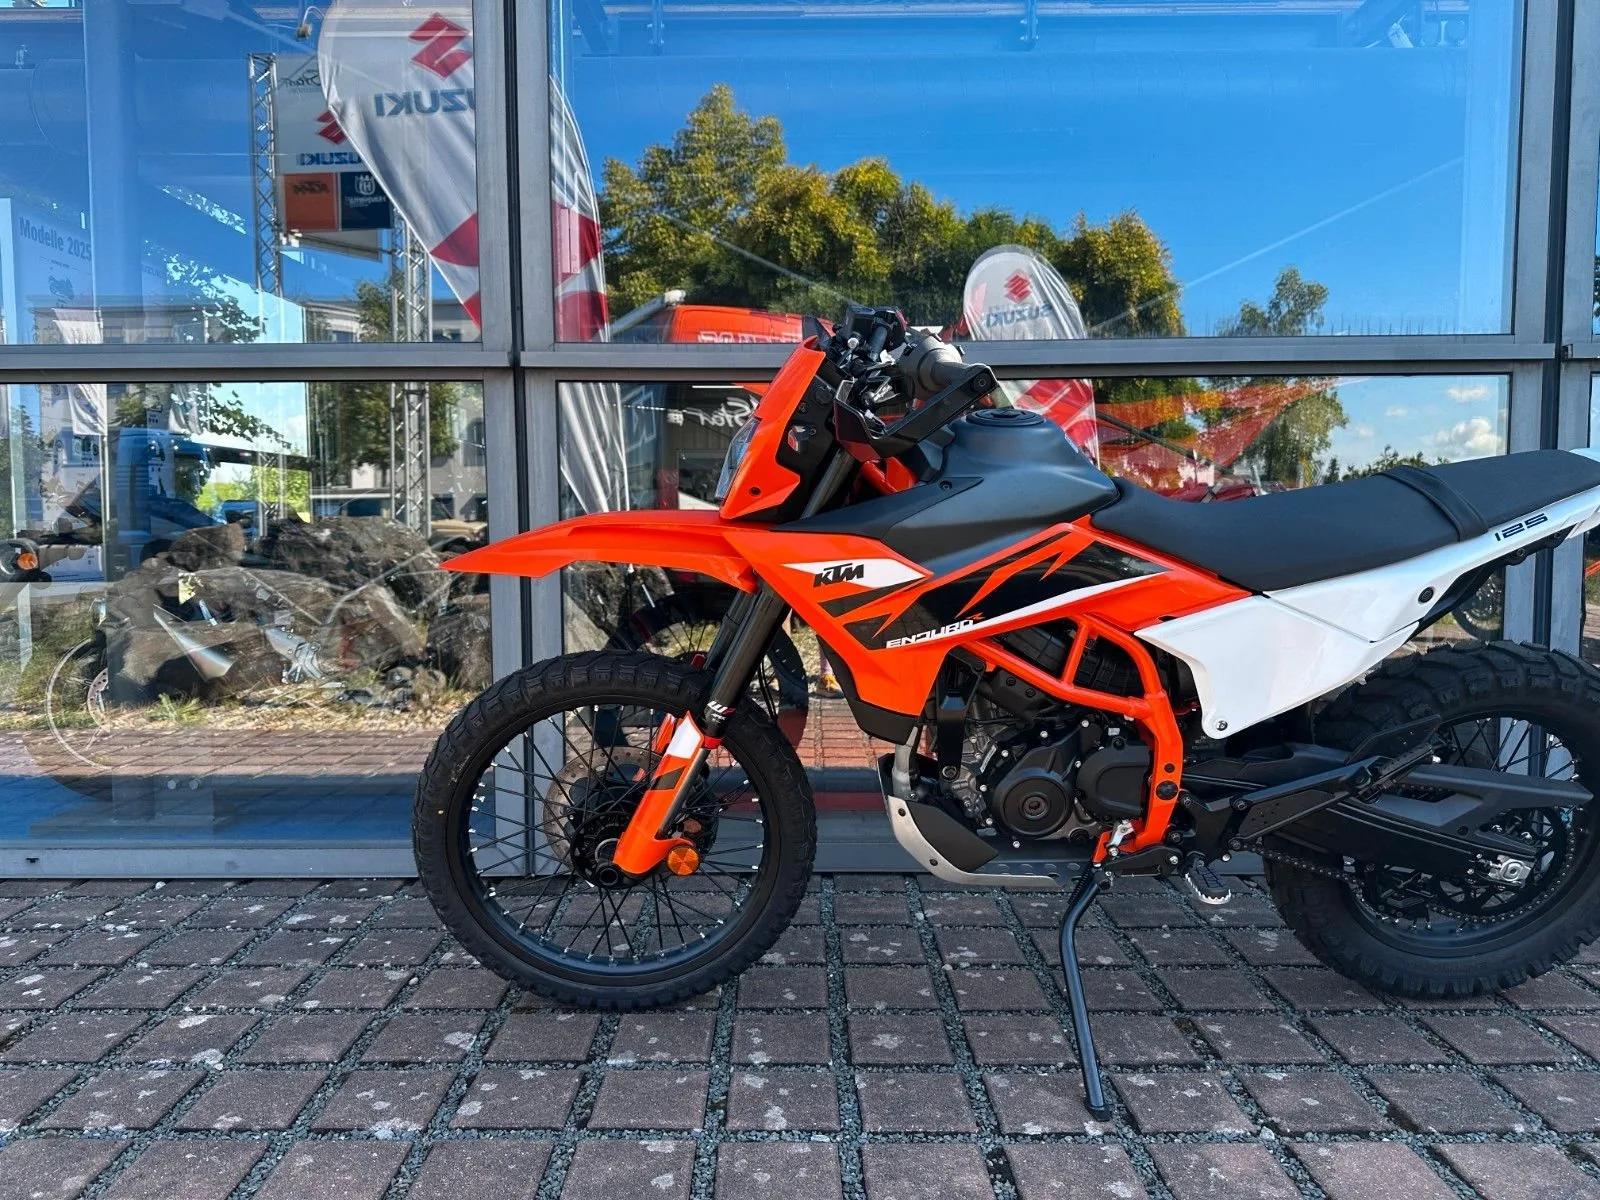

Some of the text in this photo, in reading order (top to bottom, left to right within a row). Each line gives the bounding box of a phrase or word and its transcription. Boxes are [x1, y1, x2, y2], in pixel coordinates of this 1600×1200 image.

[19, 217, 92, 261] Modelle 2025
[1494, 512, 1548, 542] 125
[813, 563, 864, 587] KTM
[886, 619, 974, 649] ENDURO
